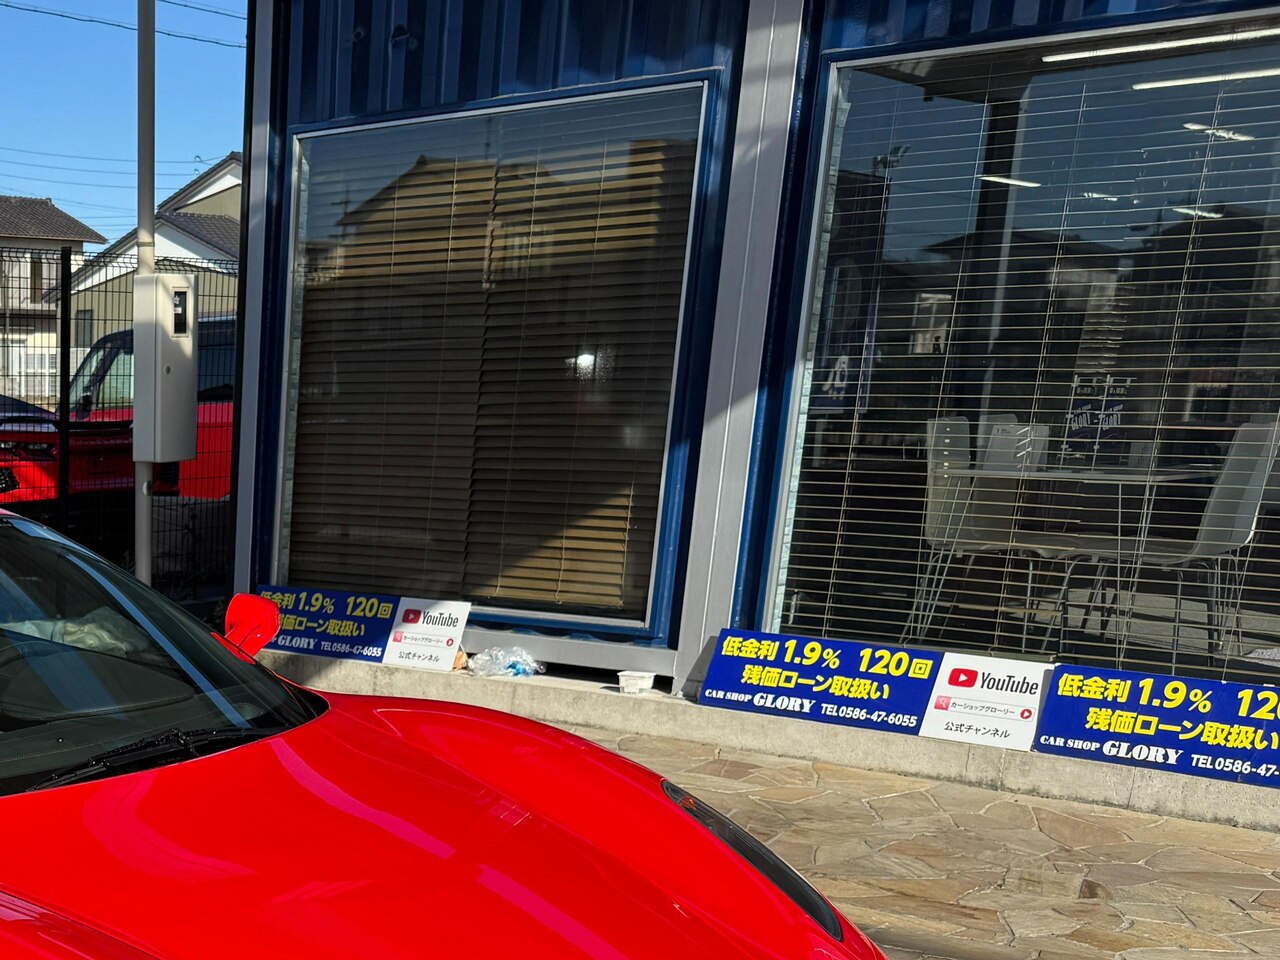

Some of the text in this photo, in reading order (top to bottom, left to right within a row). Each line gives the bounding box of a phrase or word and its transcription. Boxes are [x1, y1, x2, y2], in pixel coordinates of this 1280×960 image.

[298, 591, 336, 614] 1.9%
[346, 596, 394, 619] 120回
[422, 611, 459, 628] YouTube
[277, 635, 318, 650] GLORY
[398, 650, 440, 663] 公式チャンネル
[721, 636, 934, 679] 低金利 1.9% 120回
[740, 664, 890, 700] 残価ローン取扱い
[980, 672, 1039, 695] YouTube
[705, 689, 724, 699] CAR
[725, 691, 752, 702] SHOP
[753, 692, 816, 713] GLORY
[951, 701, 1016, 715] カーショップグローリー
[1057, 673, 1280, 721] 低金利 1.9% 12
[944, 721, 1011, 739] 公式チャンネル
[1084, 706, 1279, 750] 残価ローン取扱い
[1040, 735, 1065, 746] CAR
[1066, 738, 1100, 751] SHOP
[1102, 740, 1184, 765] GLORY
